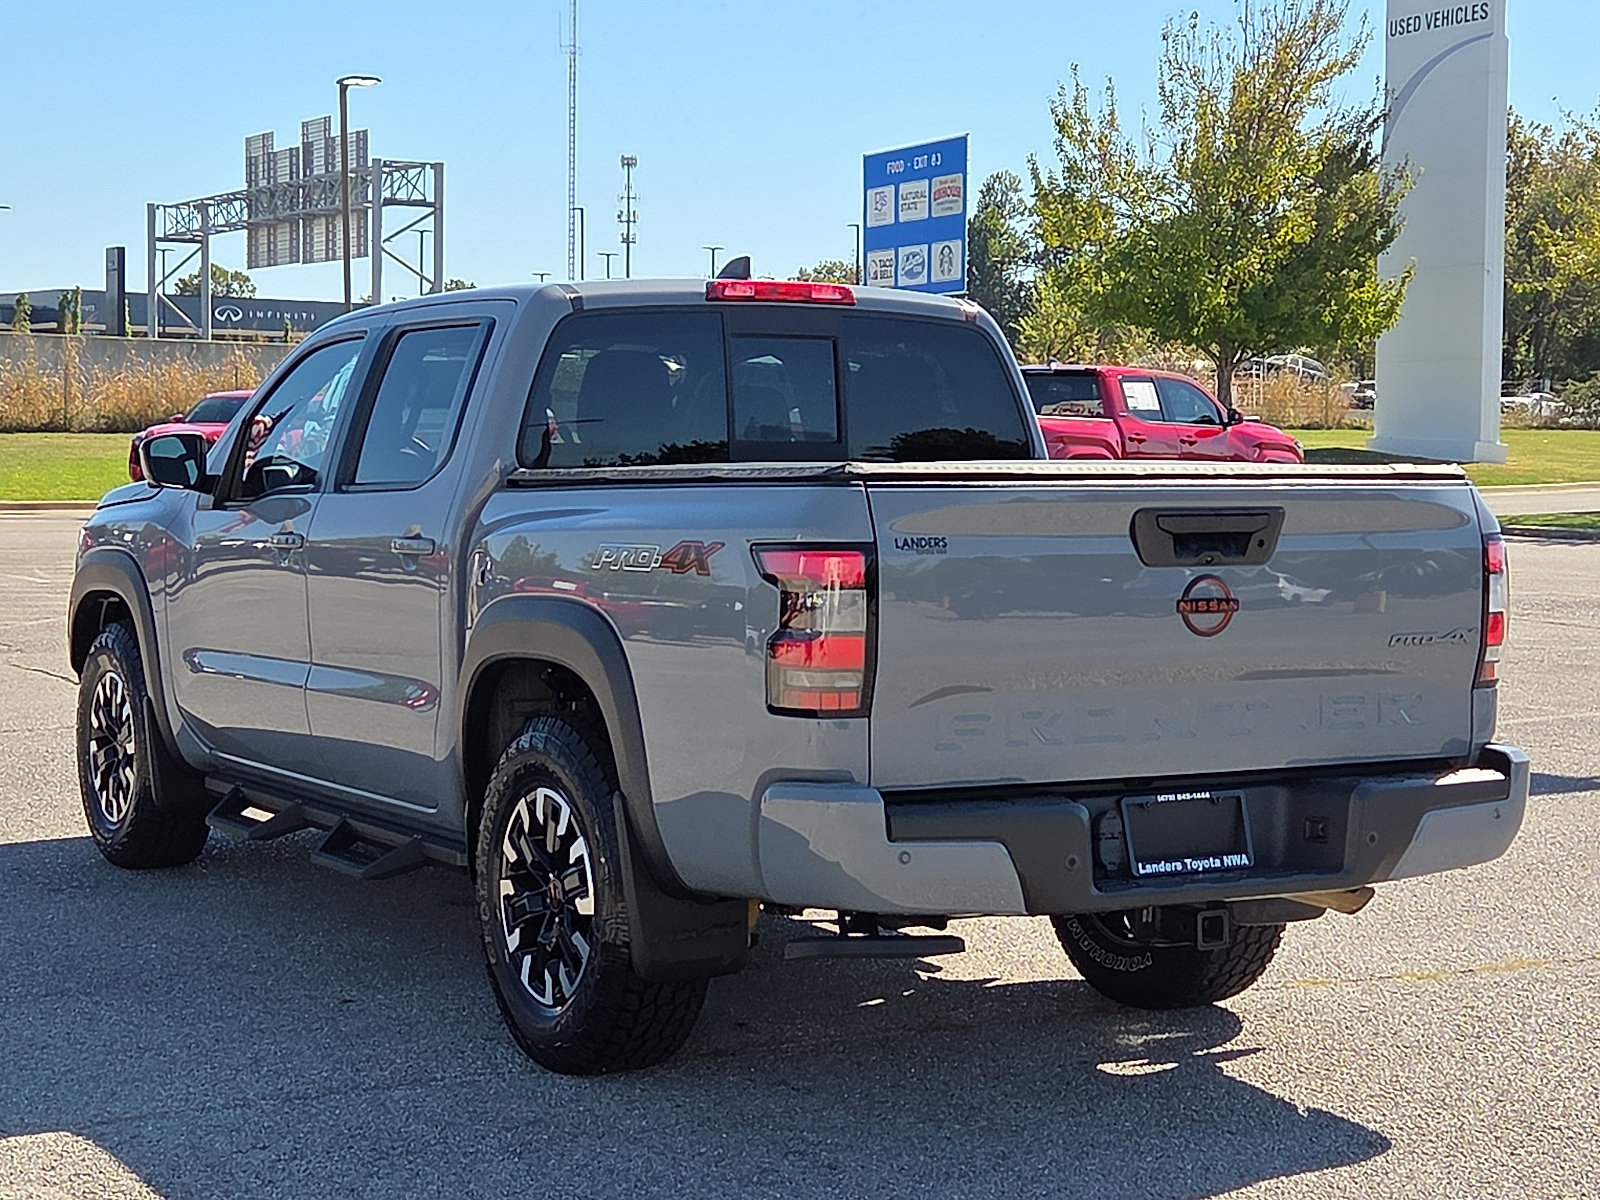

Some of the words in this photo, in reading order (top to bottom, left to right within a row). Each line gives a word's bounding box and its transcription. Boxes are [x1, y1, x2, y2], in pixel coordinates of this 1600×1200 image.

[1389, 15, 1421, 37] USED
[1425, 2, 1489, 30] VEHICLES
[887, 160, 904, 174] FOOD
[914, 155, 927, 169] EXIT
[901, 190, 927, 201] NATURAL
[901, 202, 917, 212] STATE
[879, 257, 893, 269] TACO
[880, 268, 893, 279] BELL
[249, 309, 315, 321] INFINITI
[894, 536, 948, 550] LANDERS
[1179, 600, 1238, 612] NISSAN
[1138, 860, 1183, 875] Landers
[1184, 857, 1221, 872] Toyota
[1223, 853, 1250, 866] NWA
[1063, 914, 1152, 972] YOKOHAM
